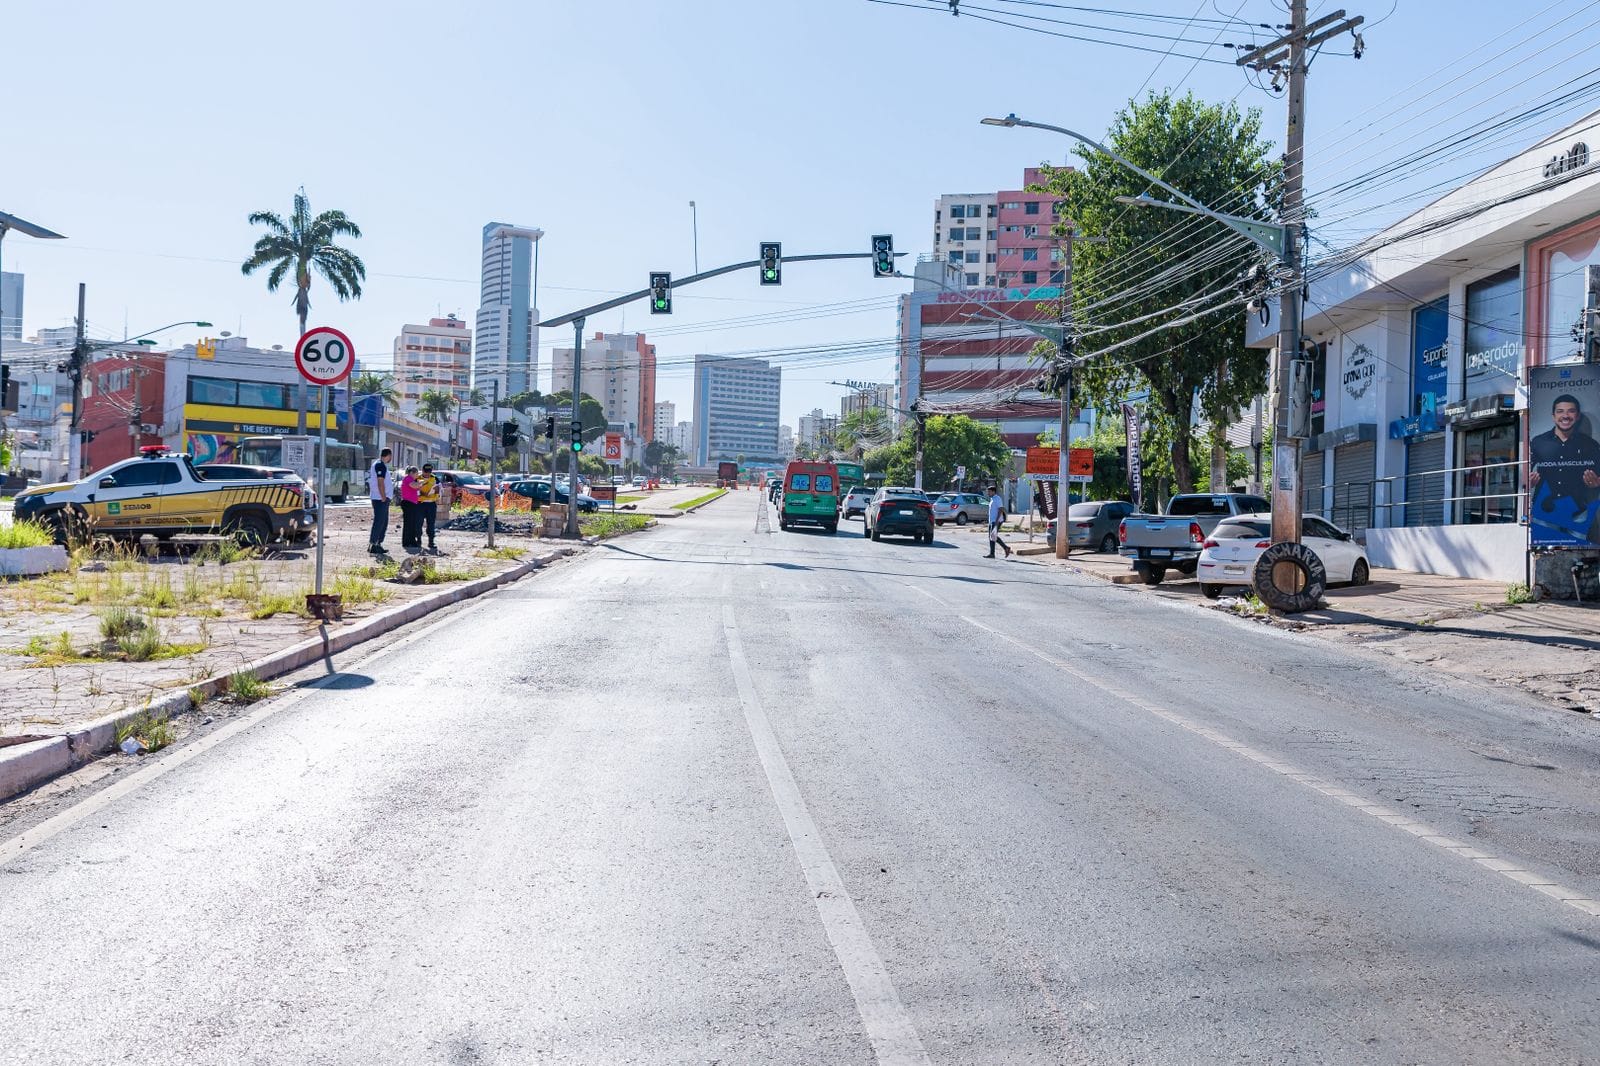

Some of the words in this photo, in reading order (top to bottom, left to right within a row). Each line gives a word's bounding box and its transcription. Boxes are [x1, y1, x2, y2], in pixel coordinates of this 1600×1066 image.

[303, 339, 345, 363] 60
[313, 366, 335, 374] km/h
[1536, 378, 1597, 390] Imperador
[242, 425, 256, 433] THE
[256, 426, 272, 434] BEST
[1129, 415, 1141, 491] IMPERADOR
[123, 503, 152, 511] SEMOB
